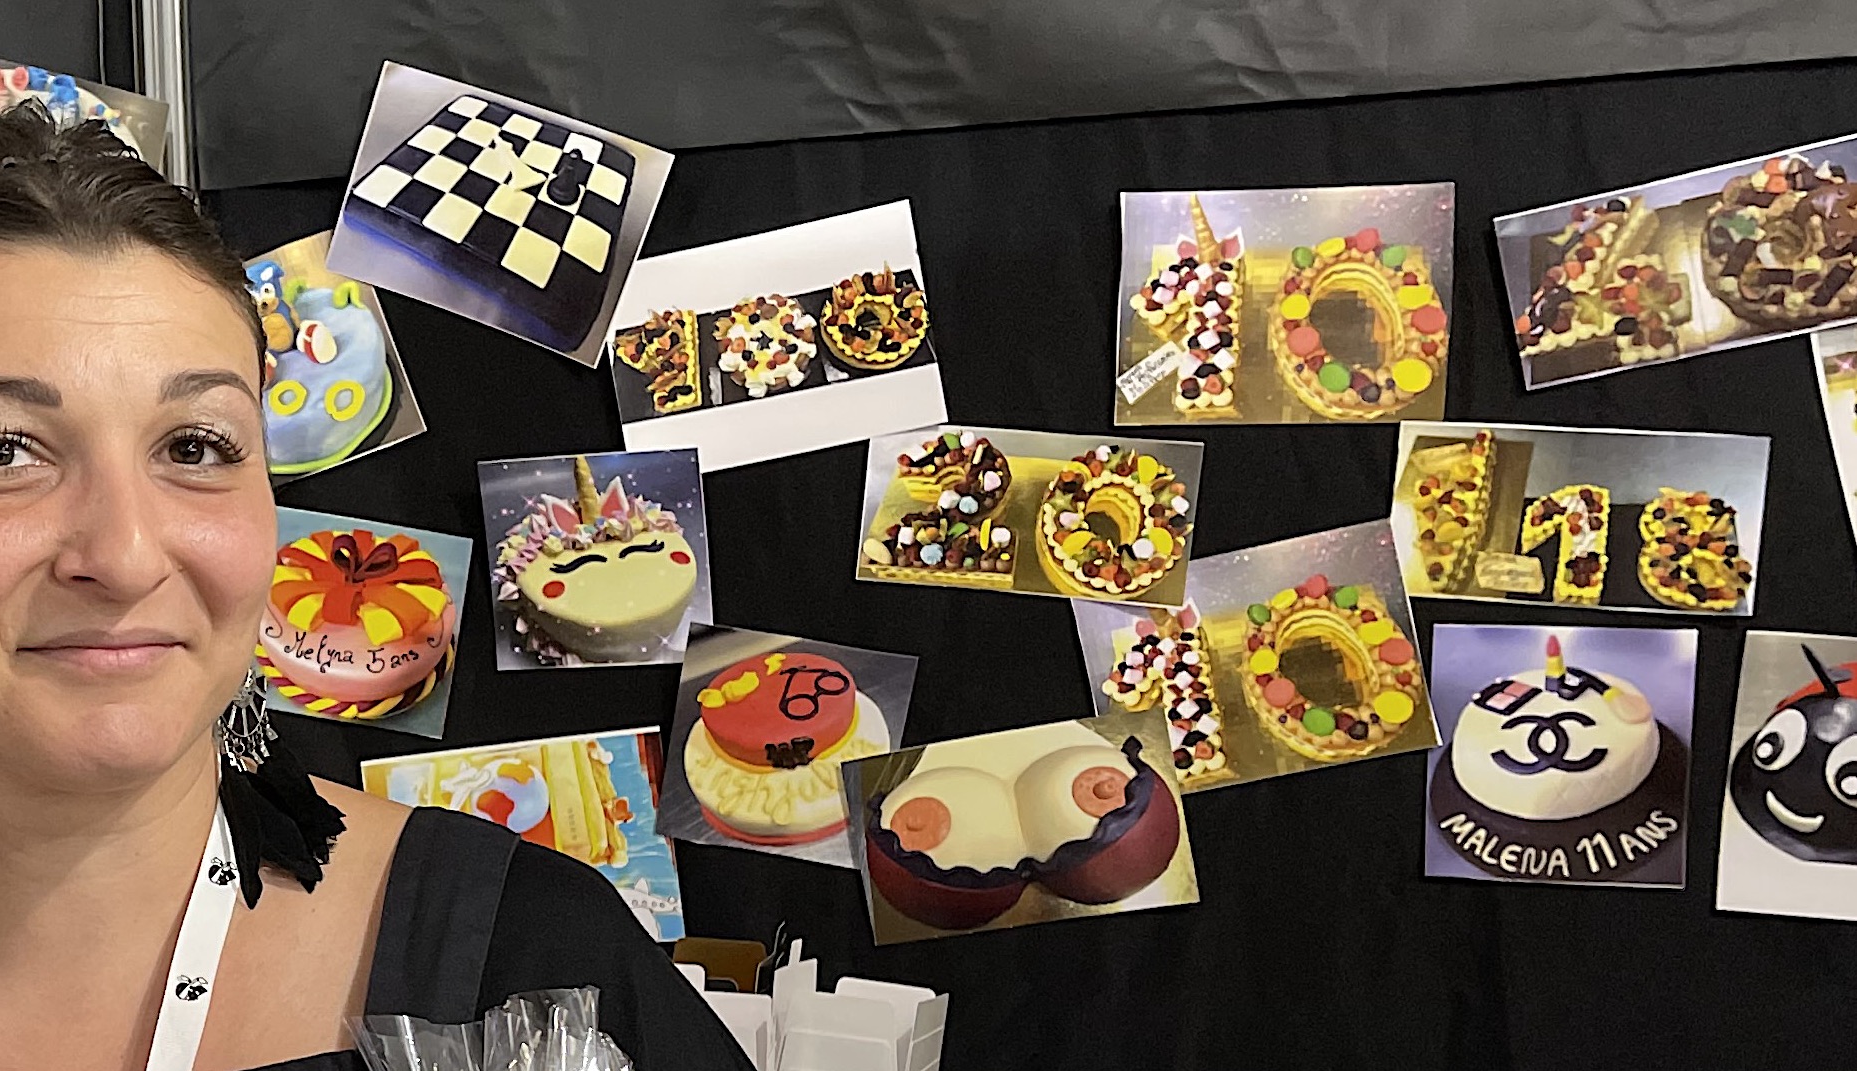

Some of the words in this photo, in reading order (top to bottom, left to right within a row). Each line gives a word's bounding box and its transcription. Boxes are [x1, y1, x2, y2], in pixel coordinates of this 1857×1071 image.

[1440, 813, 1570, 878] MALENA
[1576, 832, 1618, 874] 11
[1618, 810, 1679, 861] ANS
